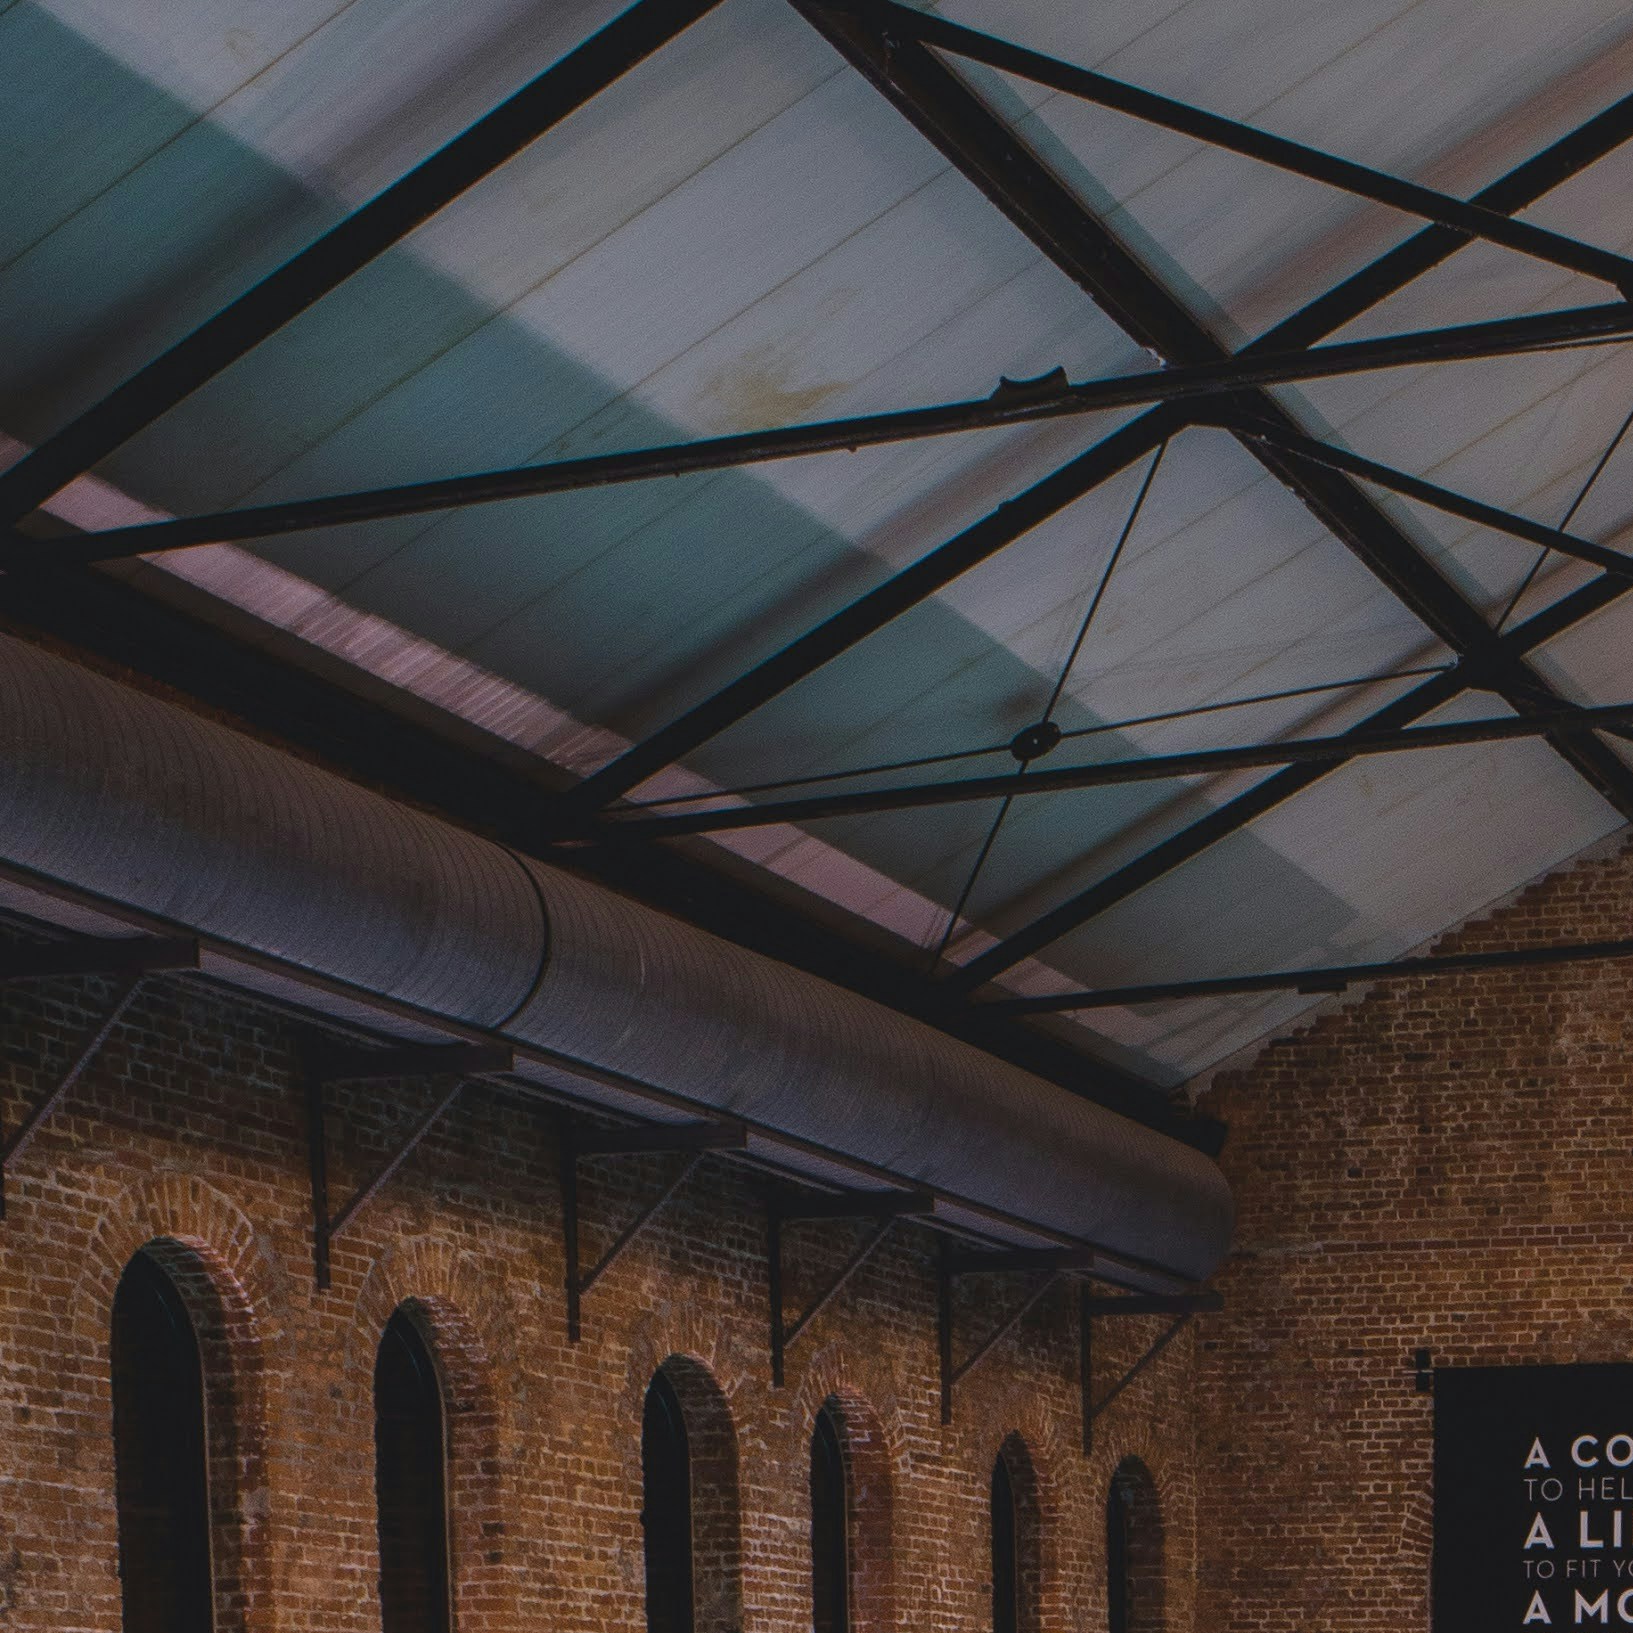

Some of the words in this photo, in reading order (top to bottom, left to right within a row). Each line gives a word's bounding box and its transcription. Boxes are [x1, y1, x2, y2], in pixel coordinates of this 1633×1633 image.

[1524, 1436, 1551, 1469] A
[1523, 1478, 1563, 1502] TO
[1523, 1511, 1555, 1550] A
[1523, 1559, 1555, 1579] TO
[1566, 1559, 1601, 1579] FIT
[1522, 1589, 1552, 1625] A
